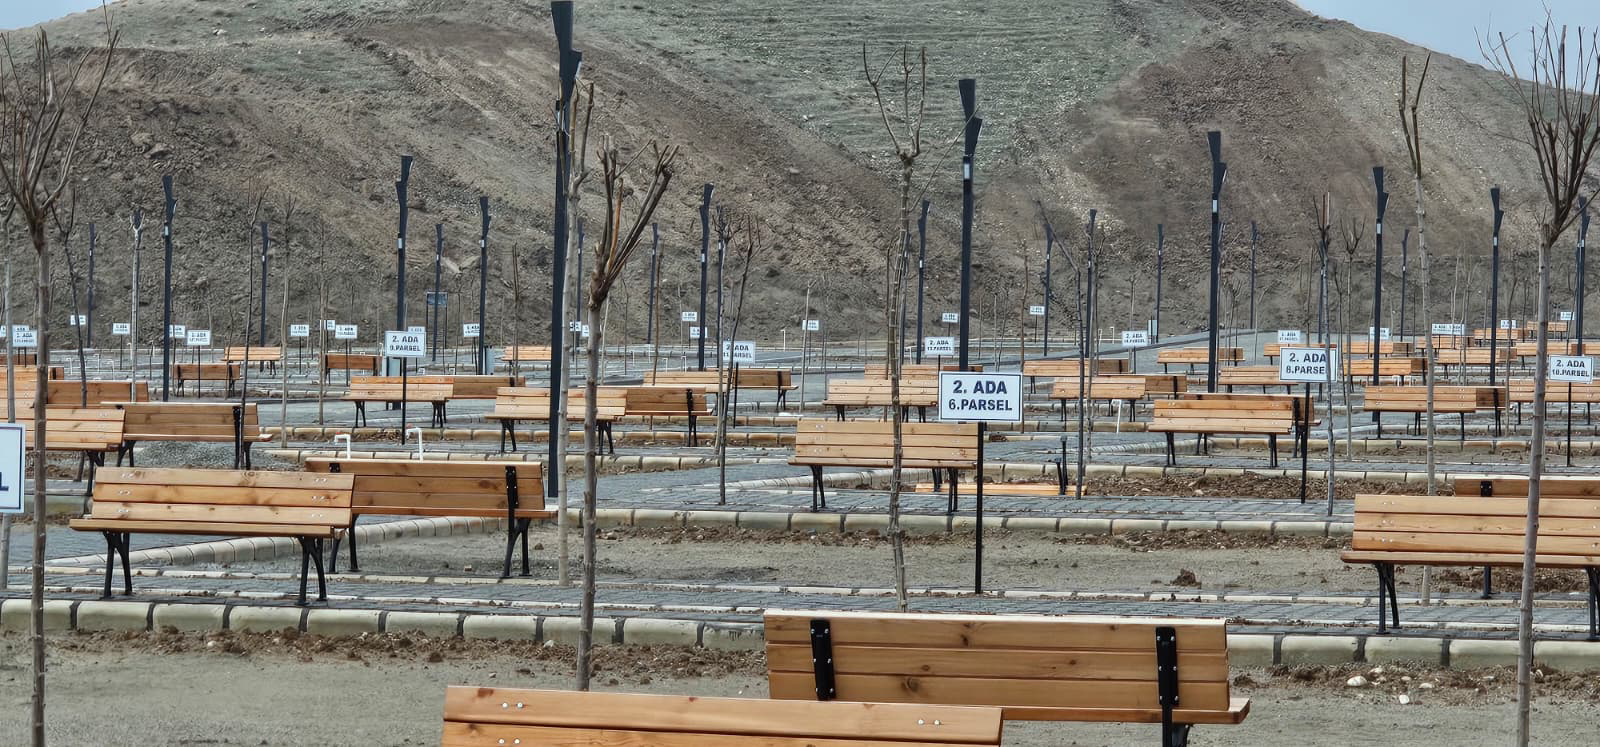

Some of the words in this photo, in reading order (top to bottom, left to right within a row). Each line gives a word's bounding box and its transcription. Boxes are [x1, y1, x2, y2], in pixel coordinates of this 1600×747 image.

[392, 335, 400, 343] 2.
[402, 335, 419, 343] ADA
[1289, 352, 1300, 363] 2.
[1303, 353, 1327, 363] ADA
[1556, 359, 1564, 368] 2.
[1566, 359, 1586, 368] ADA
[952, 379, 968, 394] 2.
[973, 380, 1008, 395] ADA
[948, 398, 1013, 411] 6.PARSEL
